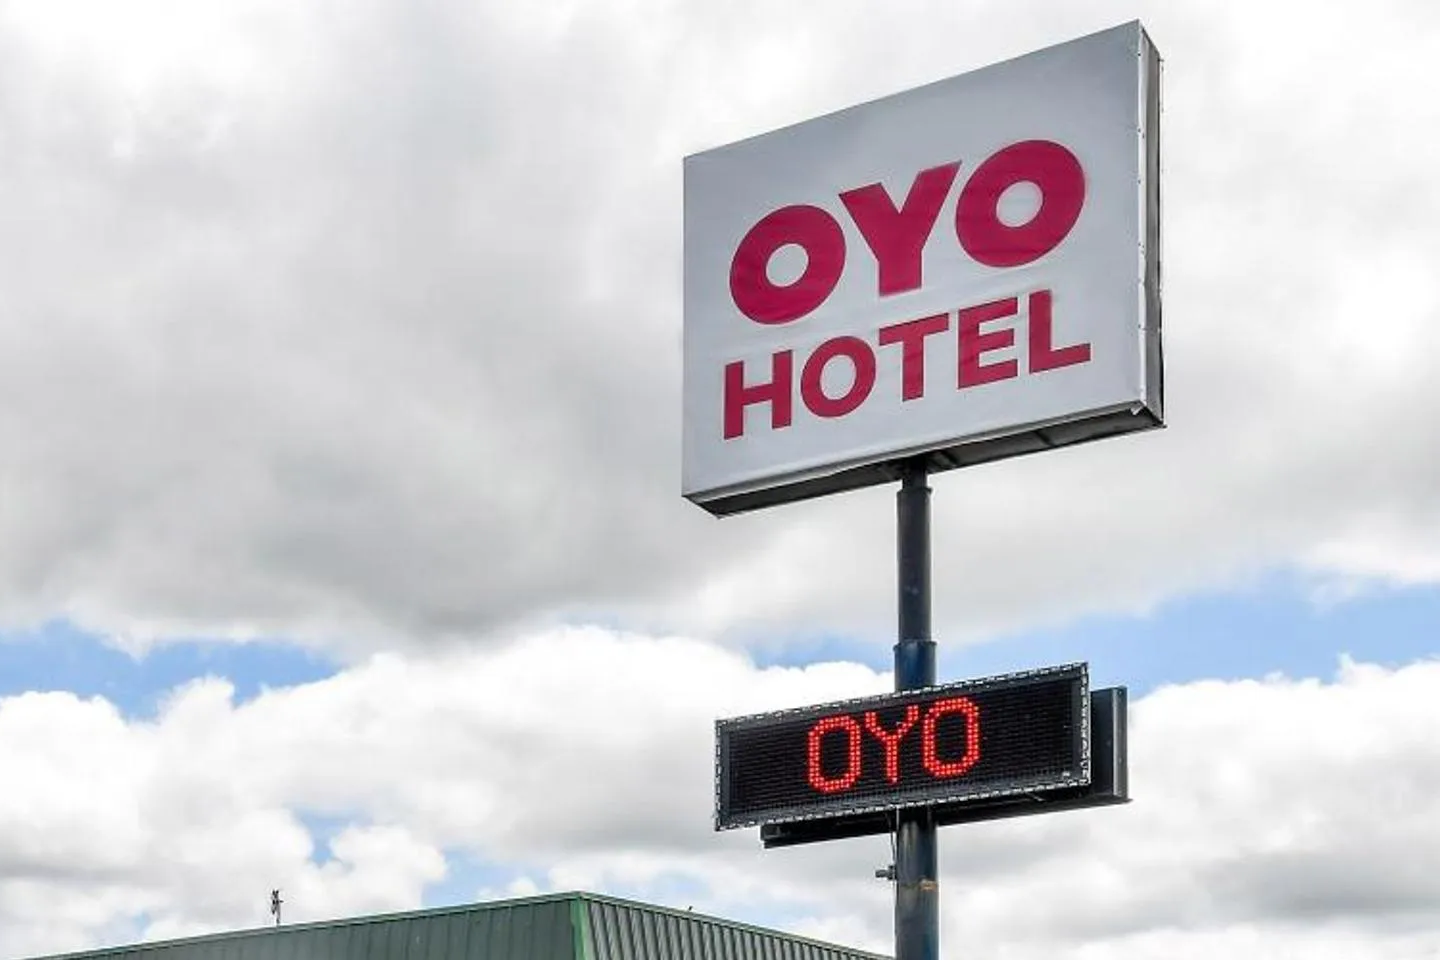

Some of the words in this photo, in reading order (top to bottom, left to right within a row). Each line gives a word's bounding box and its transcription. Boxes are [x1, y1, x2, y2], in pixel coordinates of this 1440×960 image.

[729, 139, 1086, 325] OYO
[723, 289, 1091, 440] HOTEL
[806, 696, 981, 794] OYO
